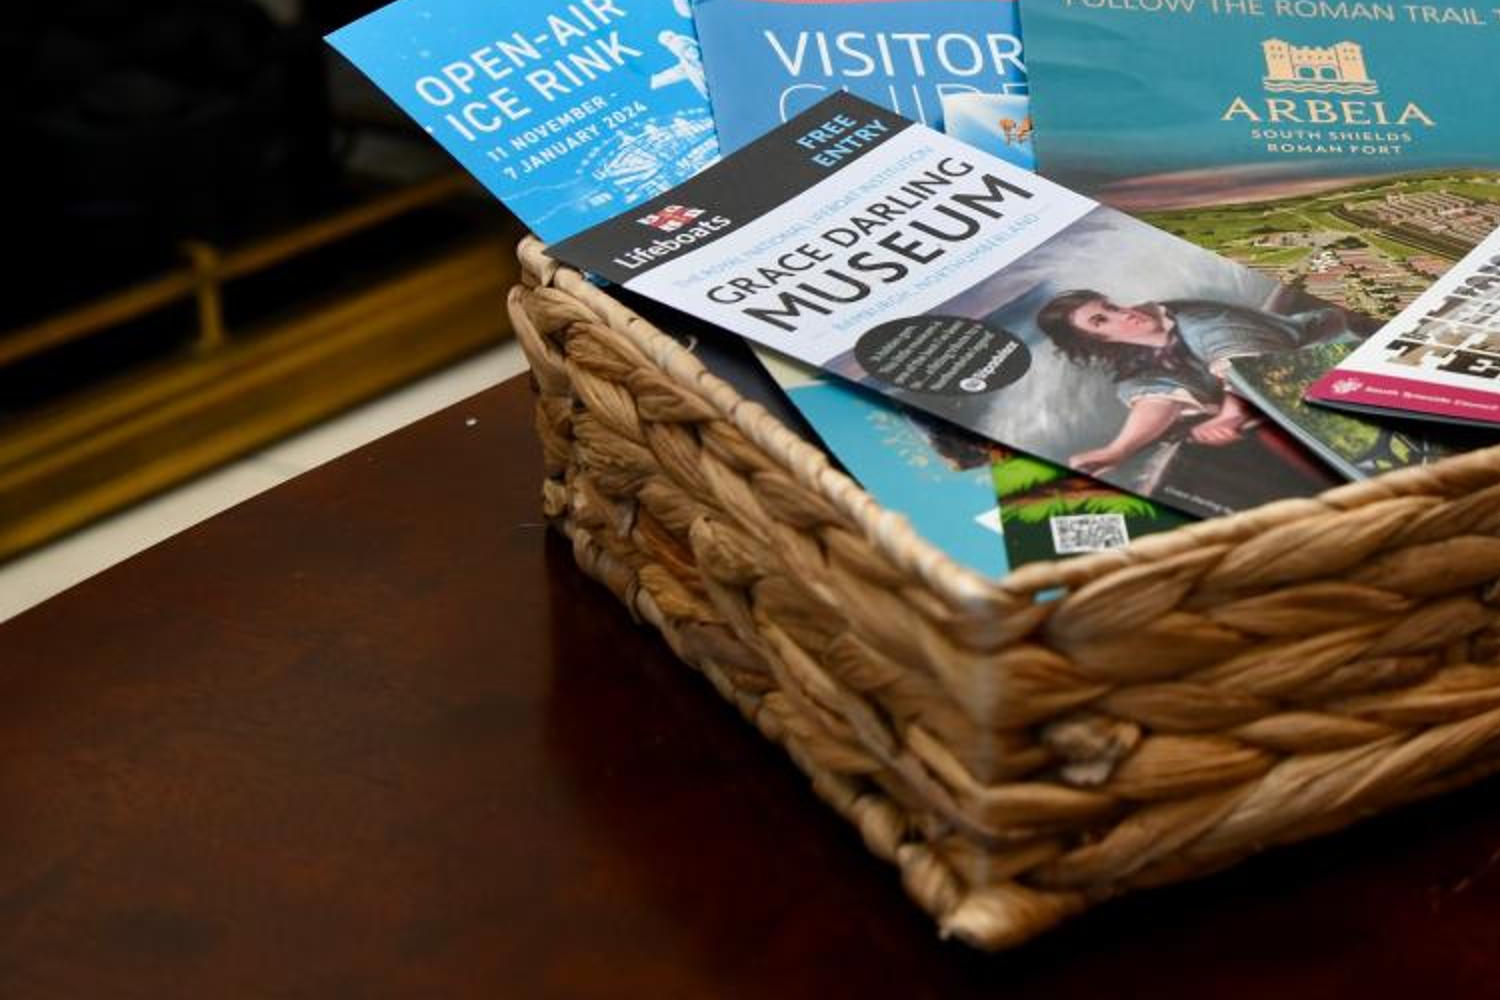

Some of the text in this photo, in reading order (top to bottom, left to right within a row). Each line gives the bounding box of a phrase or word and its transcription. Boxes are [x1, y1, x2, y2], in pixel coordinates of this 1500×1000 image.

[1275, 0, 1395, 22] ROMAN
[1402, 4, 1486, 26] TRAIL
[764, 30, 1026, 77] VISITOR
[445, 31, 644, 141] ICE RINK
[509, 95, 608, 150] NOVEMBER
[796, 113, 858, 149] FREE
[1221, 96, 1437, 127] ARBEIA
[1251, 129, 1413, 142] SOUTH SHIELDS
[503, 167, 518, 180] 7
[523, 124, 601, 173] JANUARY
[603, 101, 648, 129] 2024
[811, 119, 890, 167] ENTRY
[1267, 143, 1401, 155] ROMAN FORT
[613, 215, 731, 269] Lifeboats
[706, 156, 974, 304] GRACE DARLING
[741, 173, 1034, 332] MUSEUM
